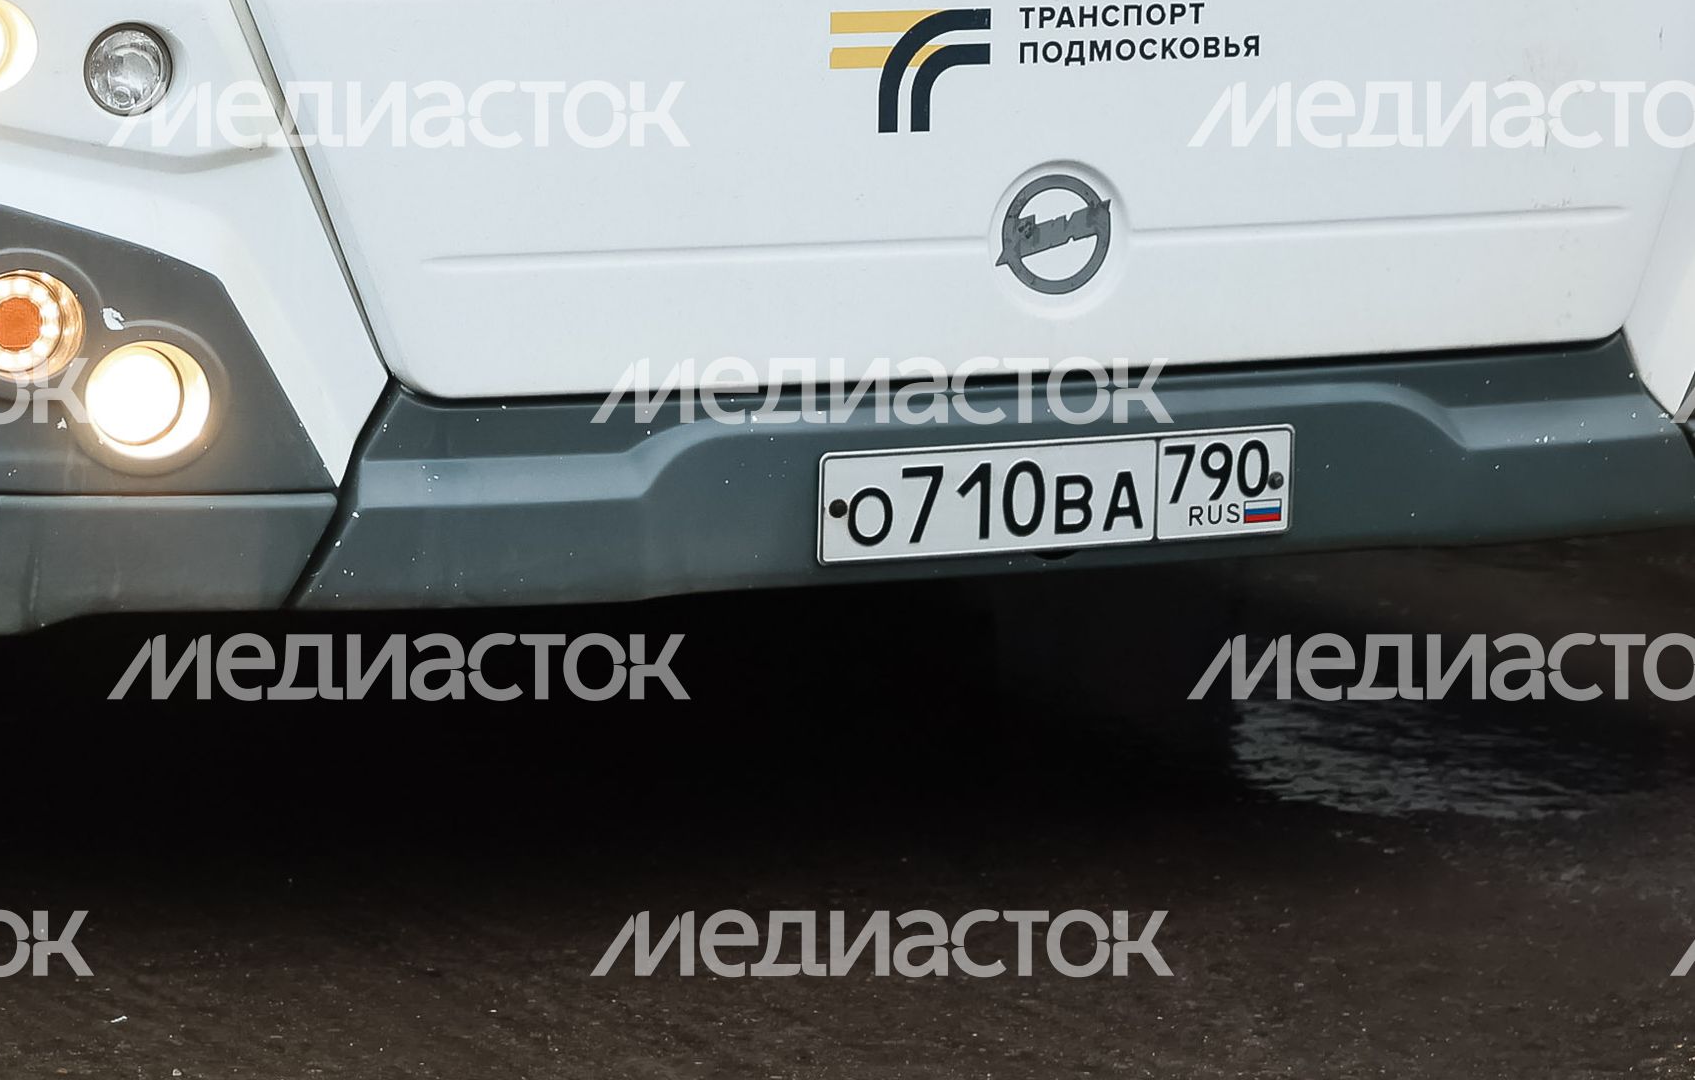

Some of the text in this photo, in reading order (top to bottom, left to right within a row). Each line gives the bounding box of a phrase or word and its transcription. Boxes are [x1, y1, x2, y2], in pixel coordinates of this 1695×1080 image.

[1019, 2, 1205, 29] ТРАНСПОРТ
[1019, 34, 1260, 67] ПОДМОСКОВЬЯ
[1164, 439, 1271, 504] 790
[1188, 503, 1241, 527] RUS
